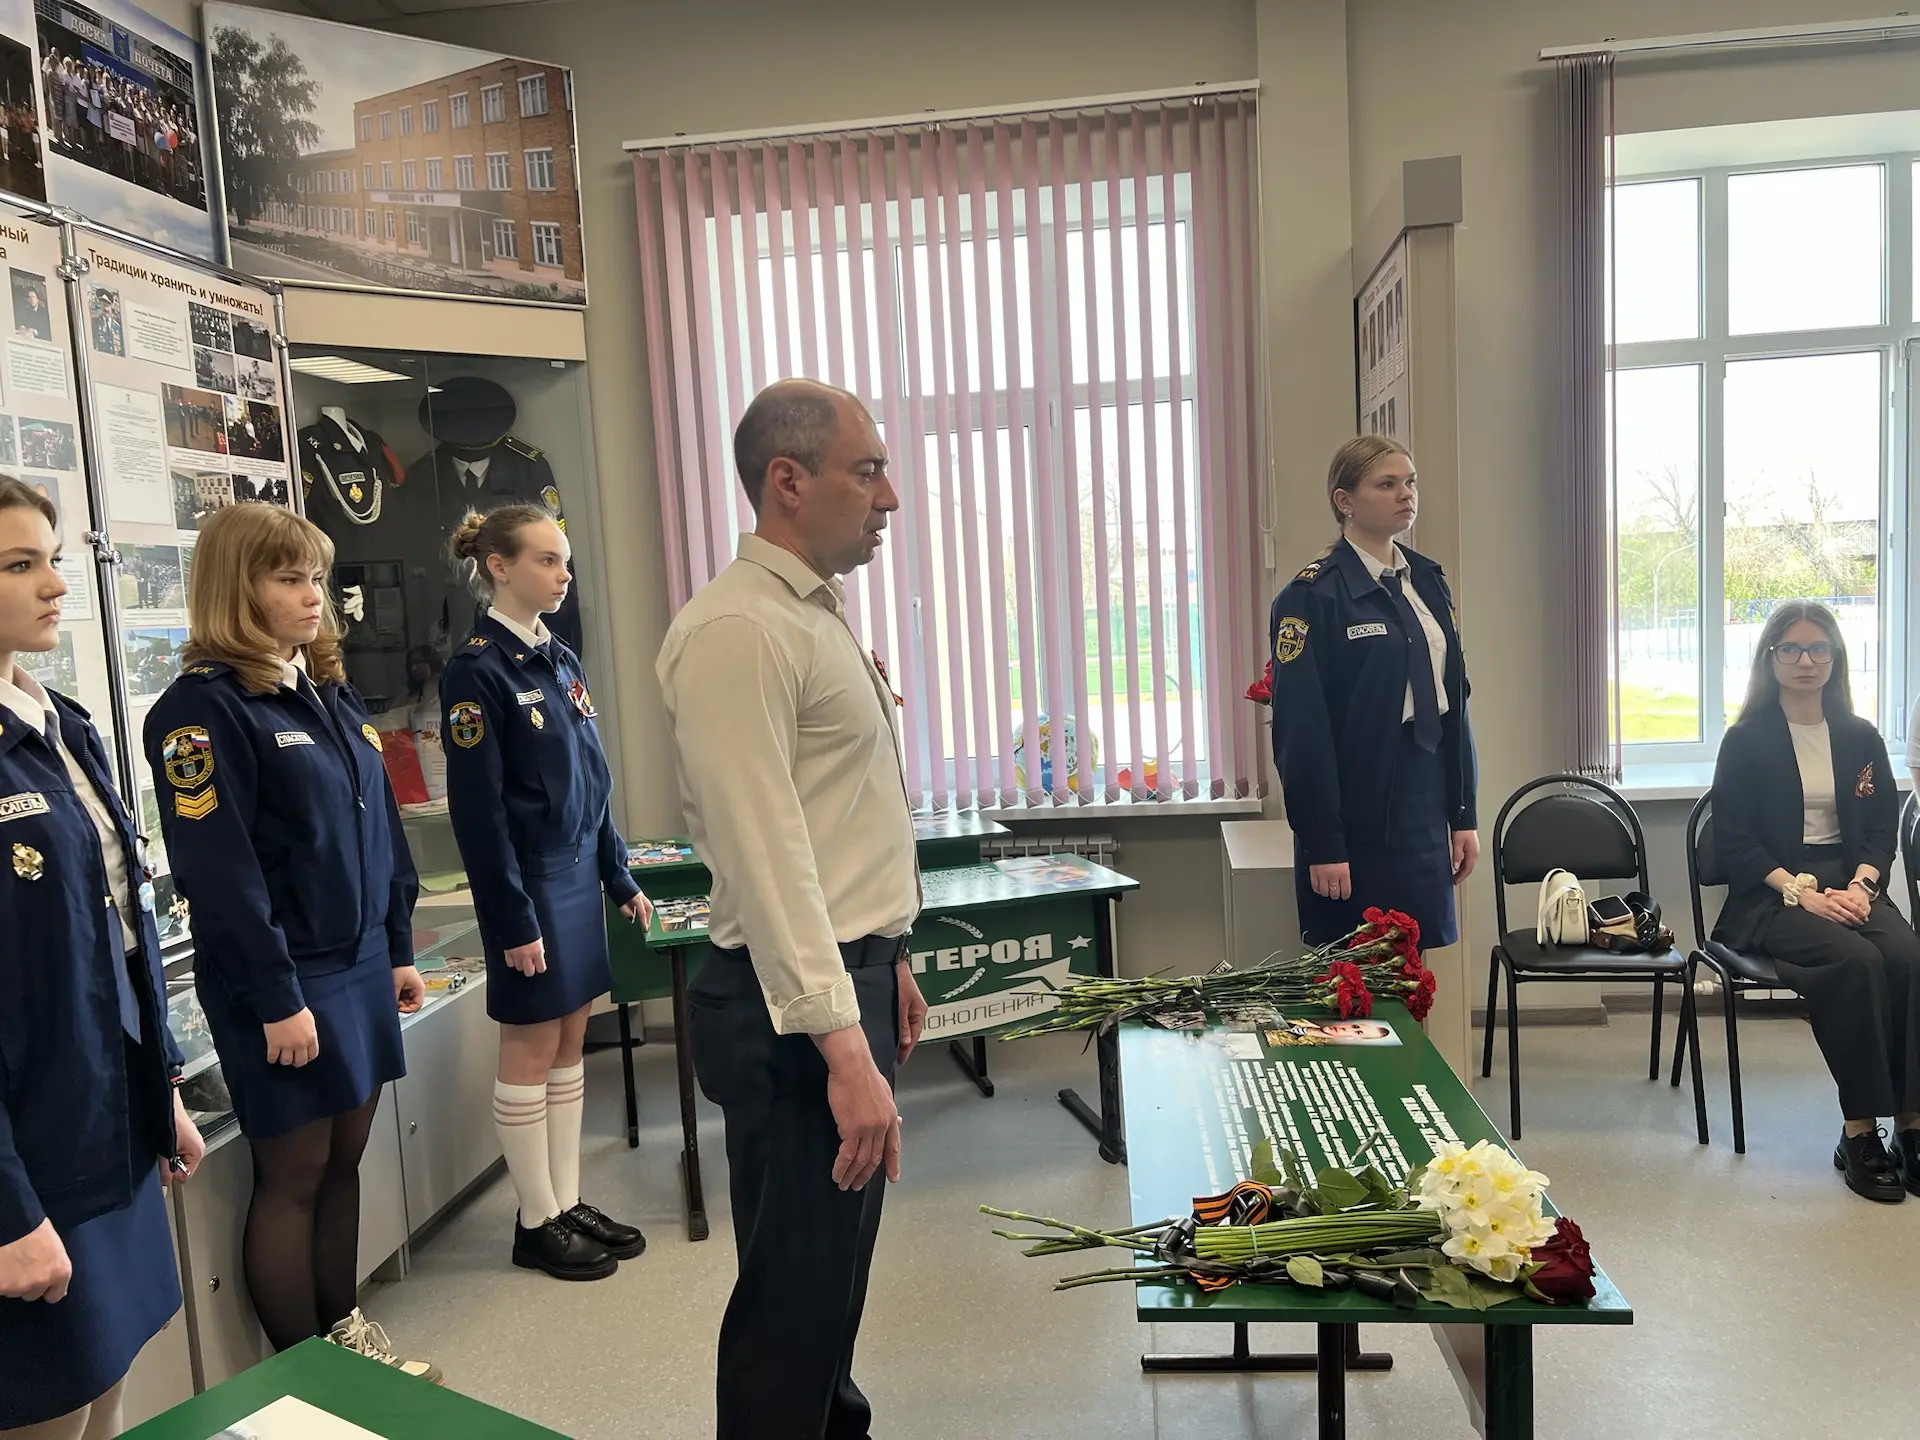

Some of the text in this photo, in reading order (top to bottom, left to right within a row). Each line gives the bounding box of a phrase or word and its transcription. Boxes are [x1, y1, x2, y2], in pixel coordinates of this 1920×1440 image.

[70, 17, 110, 46] ДОСКА
[134, 51, 173, 82] ПОЧЕТА
[88, 248, 263, 315] Традиции хранить и умножать!
[911, 933, 1053, 974] ГЕРОЯ
